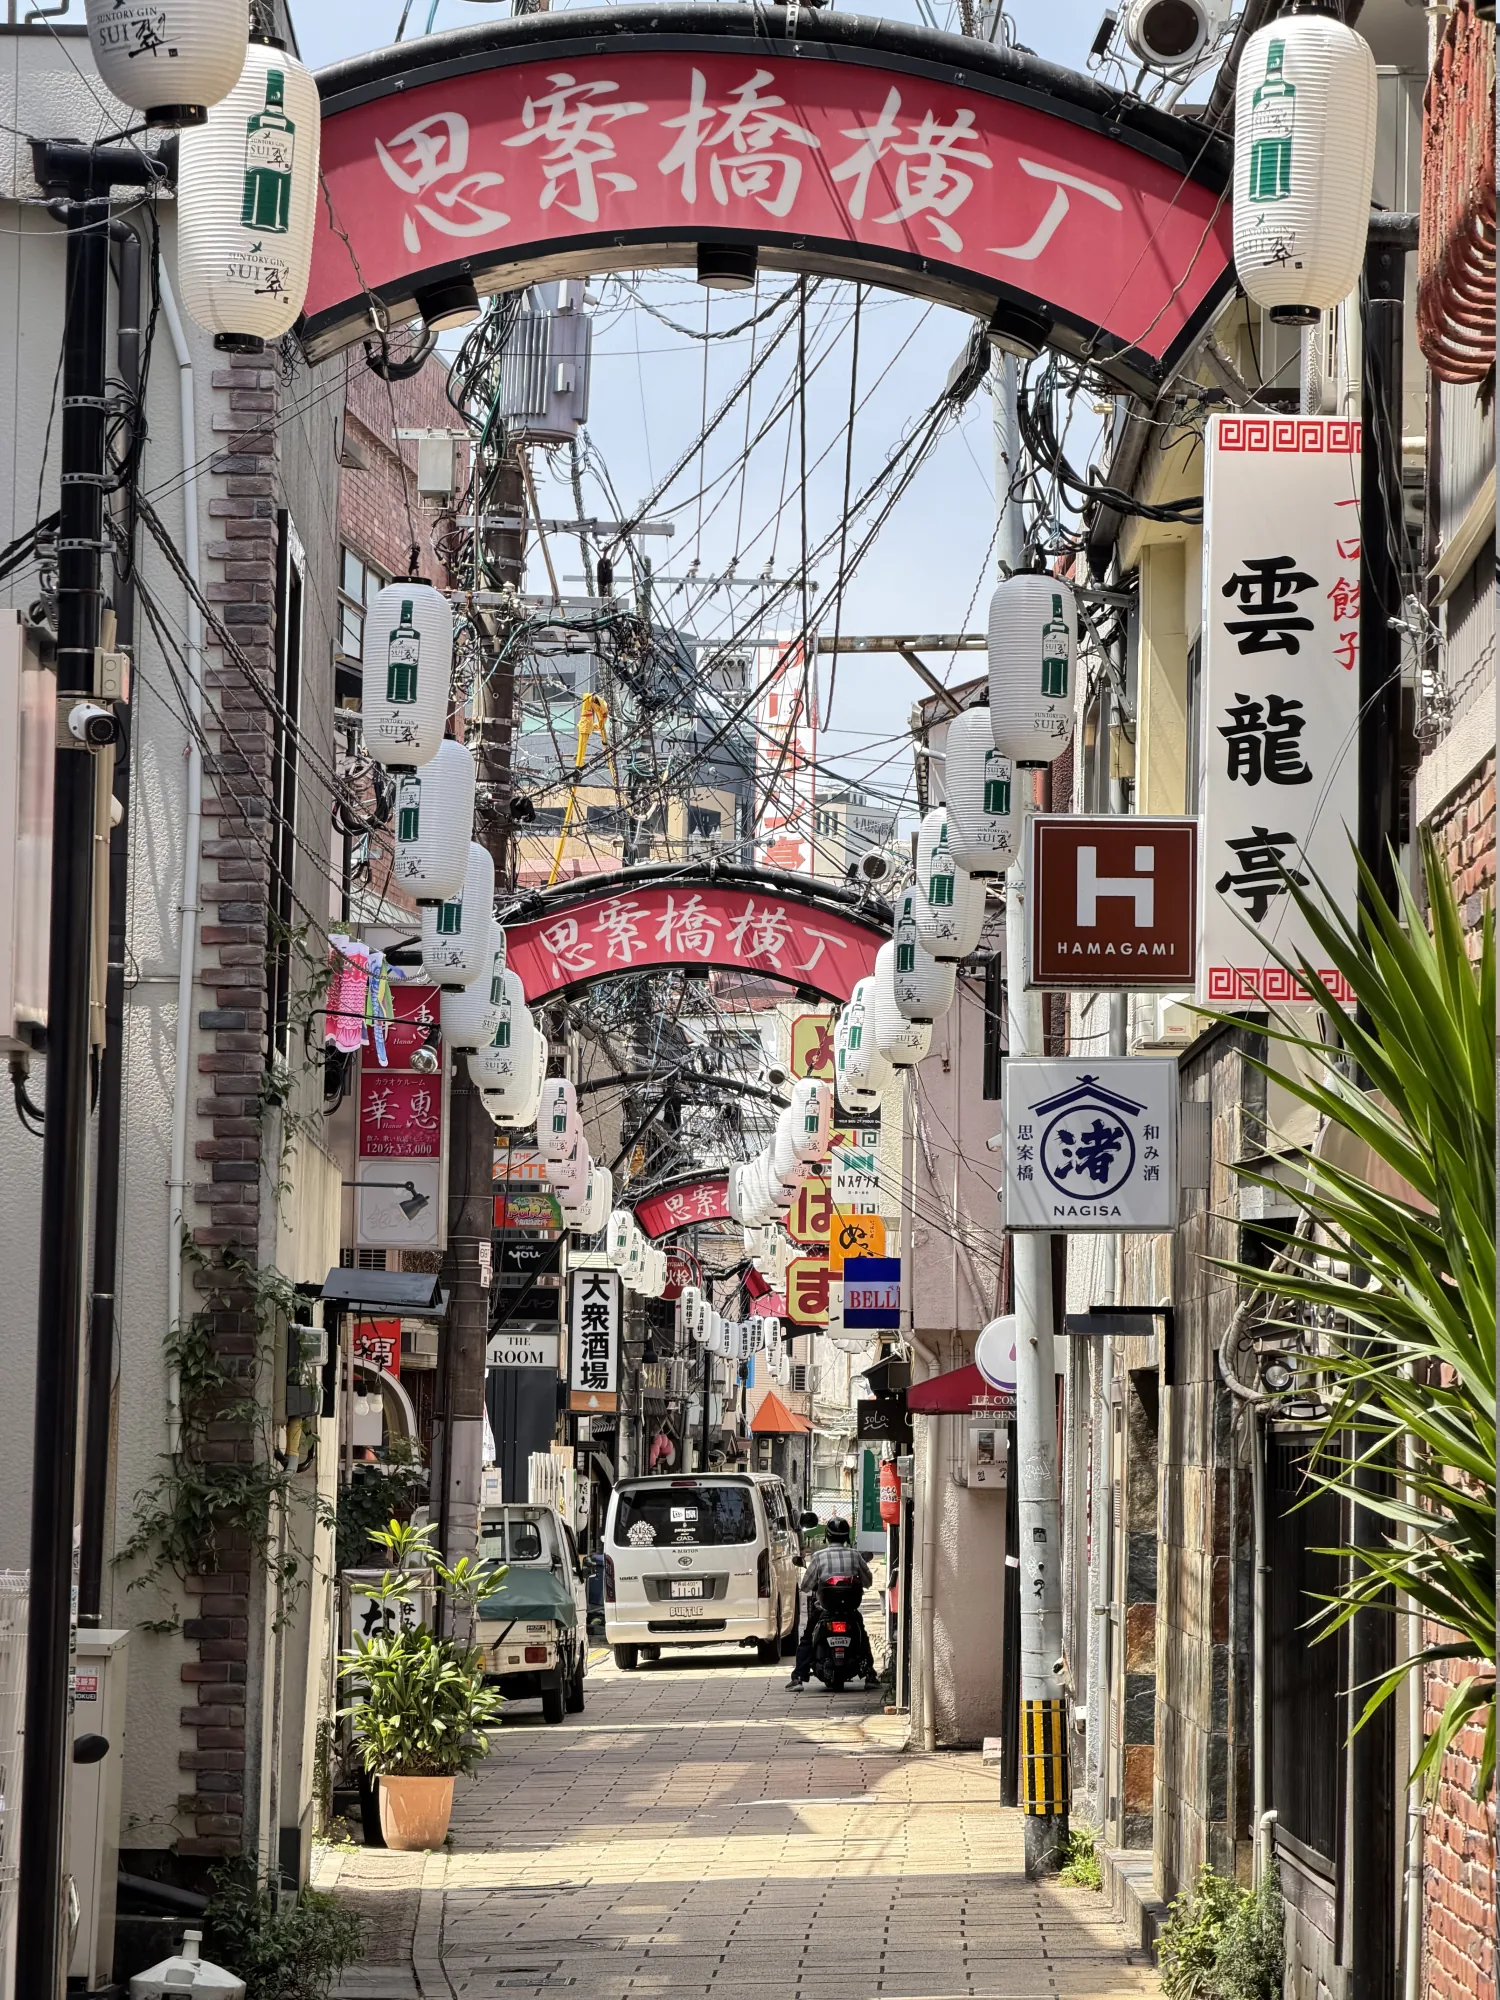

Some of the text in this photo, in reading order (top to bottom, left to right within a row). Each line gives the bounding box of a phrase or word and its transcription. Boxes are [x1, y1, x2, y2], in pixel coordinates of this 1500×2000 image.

[97, 6, 157, 24] SUNTORY GIN
[100, 23, 130, 46] SUI
[375, 66, 1122, 260] 思案橋横丁
[228, 252, 285, 267] SUNTORY GIN
[226, 264, 260, 280] SUI
[379, 725, 399, 734] SUI
[1034, 719, 1054, 730] SUI
[1215, 555, 1319, 922] 雲龍亭
[976, 833, 996, 842] SUI
[539, 893, 847, 979] 思案橋横丁
[1058, 942, 1175, 956] HAMAGAMI
[375, 1078, 426, 1086] カラオケルーム
[1017, 1125, 1033, 1181] 思案橋
[1143, 1125, 1159, 1181] 和み酒
[1054, 1206, 1121, 1216] NAGISA
[508, 1250, 547, 1269] you
[581, 1273, 610, 1390] 大衆酒場
[507, 1337, 531, 1346] THE
[493, 1351, 544, 1363] ROOM
[975, 1396, 989, 1405] LE
[976, 1411, 990, 1419] DE
[670, 1606, 703, 1617] BURTLE
